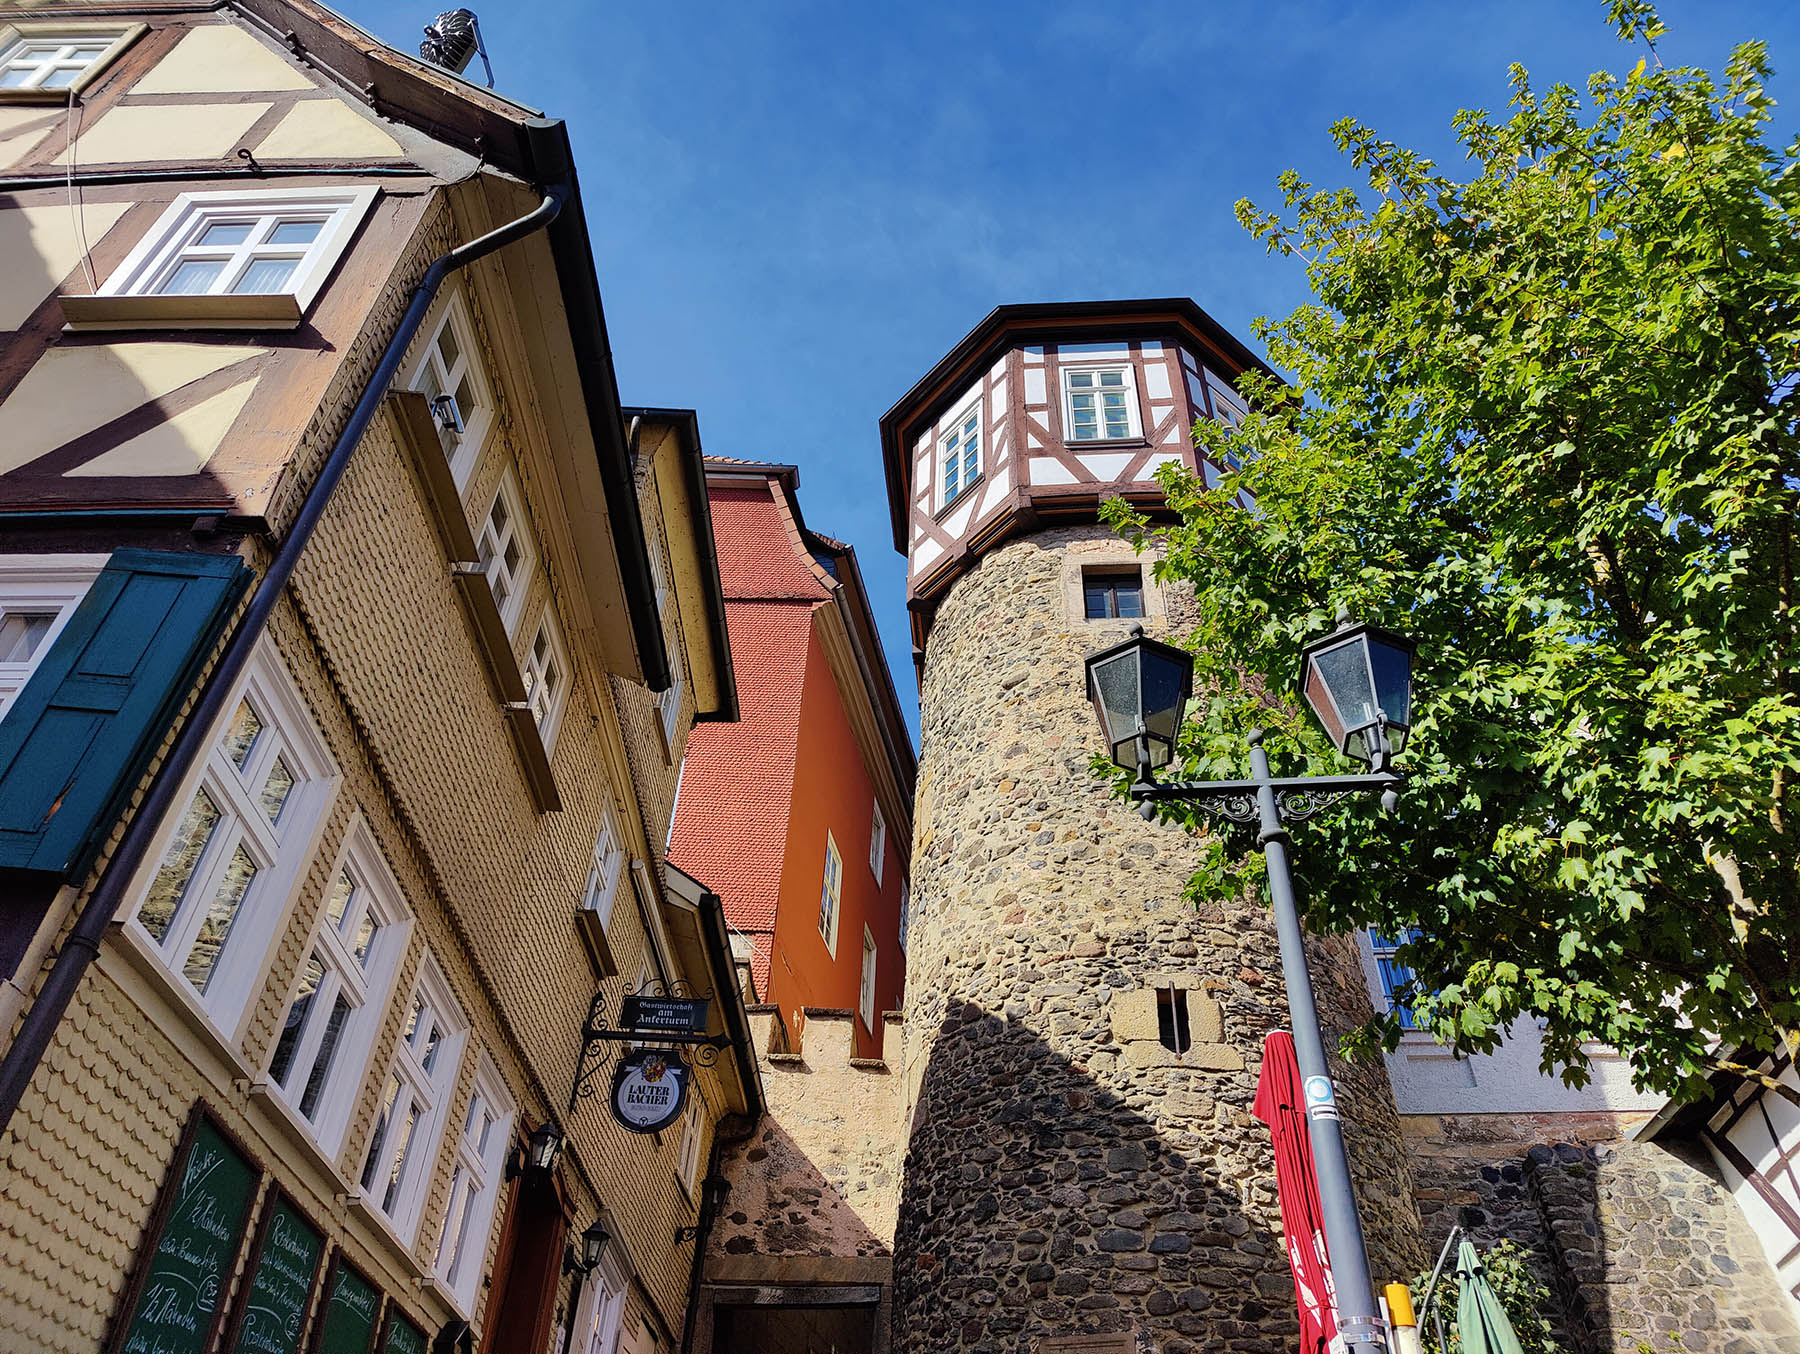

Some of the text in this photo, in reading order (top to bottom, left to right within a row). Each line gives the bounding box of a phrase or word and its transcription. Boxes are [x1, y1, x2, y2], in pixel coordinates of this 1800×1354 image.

[639, 1001, 694, 1011] Gastwirtschaft
[658, 1009, 673, 1017] am
[636, 1013, 689, 1025] Ankerturm
[629, 1085, 670, 1096] LAUTER
[627, 1094, 668, 1105] BACHER
